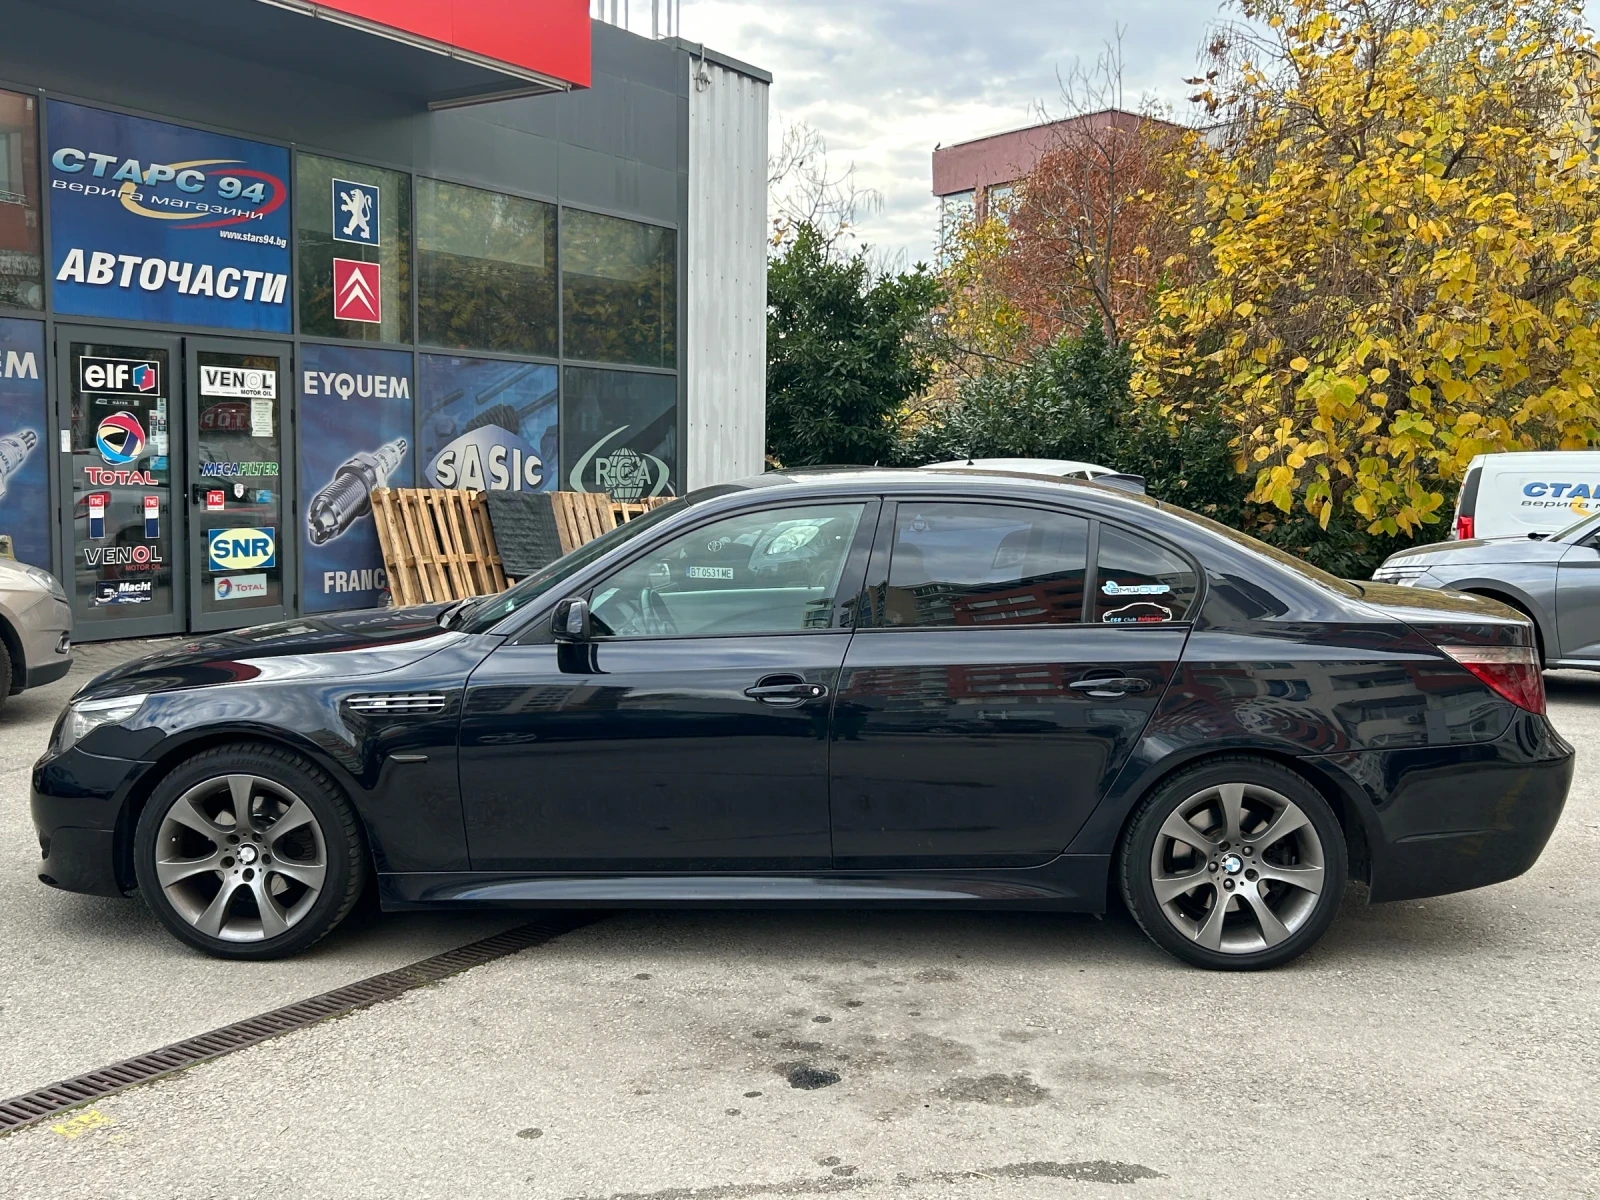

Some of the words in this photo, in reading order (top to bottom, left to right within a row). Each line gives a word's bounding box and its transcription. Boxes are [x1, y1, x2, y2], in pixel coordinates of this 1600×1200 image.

[52, 147, 206, 193] СТАРС
[217, 177, 265, 204] 94
[51, 179, 143, 202] верига
[150, 195, 265, 220] магазини
[219, 230, 287, 248] www.stars94.bg
[56, 248, 288, 304] АВТОЧАСТИ
[85, 363, 129, 388] elf
[205, 369, 272, 390] VENOL
[303, 370, 410, 400] EYQUEM
[84, 466, 158, 485] TOTAL
[202, 462, 279, 477] MECAFILTER
[435, 443, 544, 490] SASIC
[595, 457, 652, 485] RCA
[1521, 500, 1590, 509] верига
[84, 545, 163, 566] VENOL
[213, 538, 270, 559] SNR
[691, 568, 701, 577] BT
[702, 569, 720, 578] 0531
[721, 569, 731, 578] ME
[119, 582, 151, 592] Macht
[234, 583, 265, 592] TOTAL
